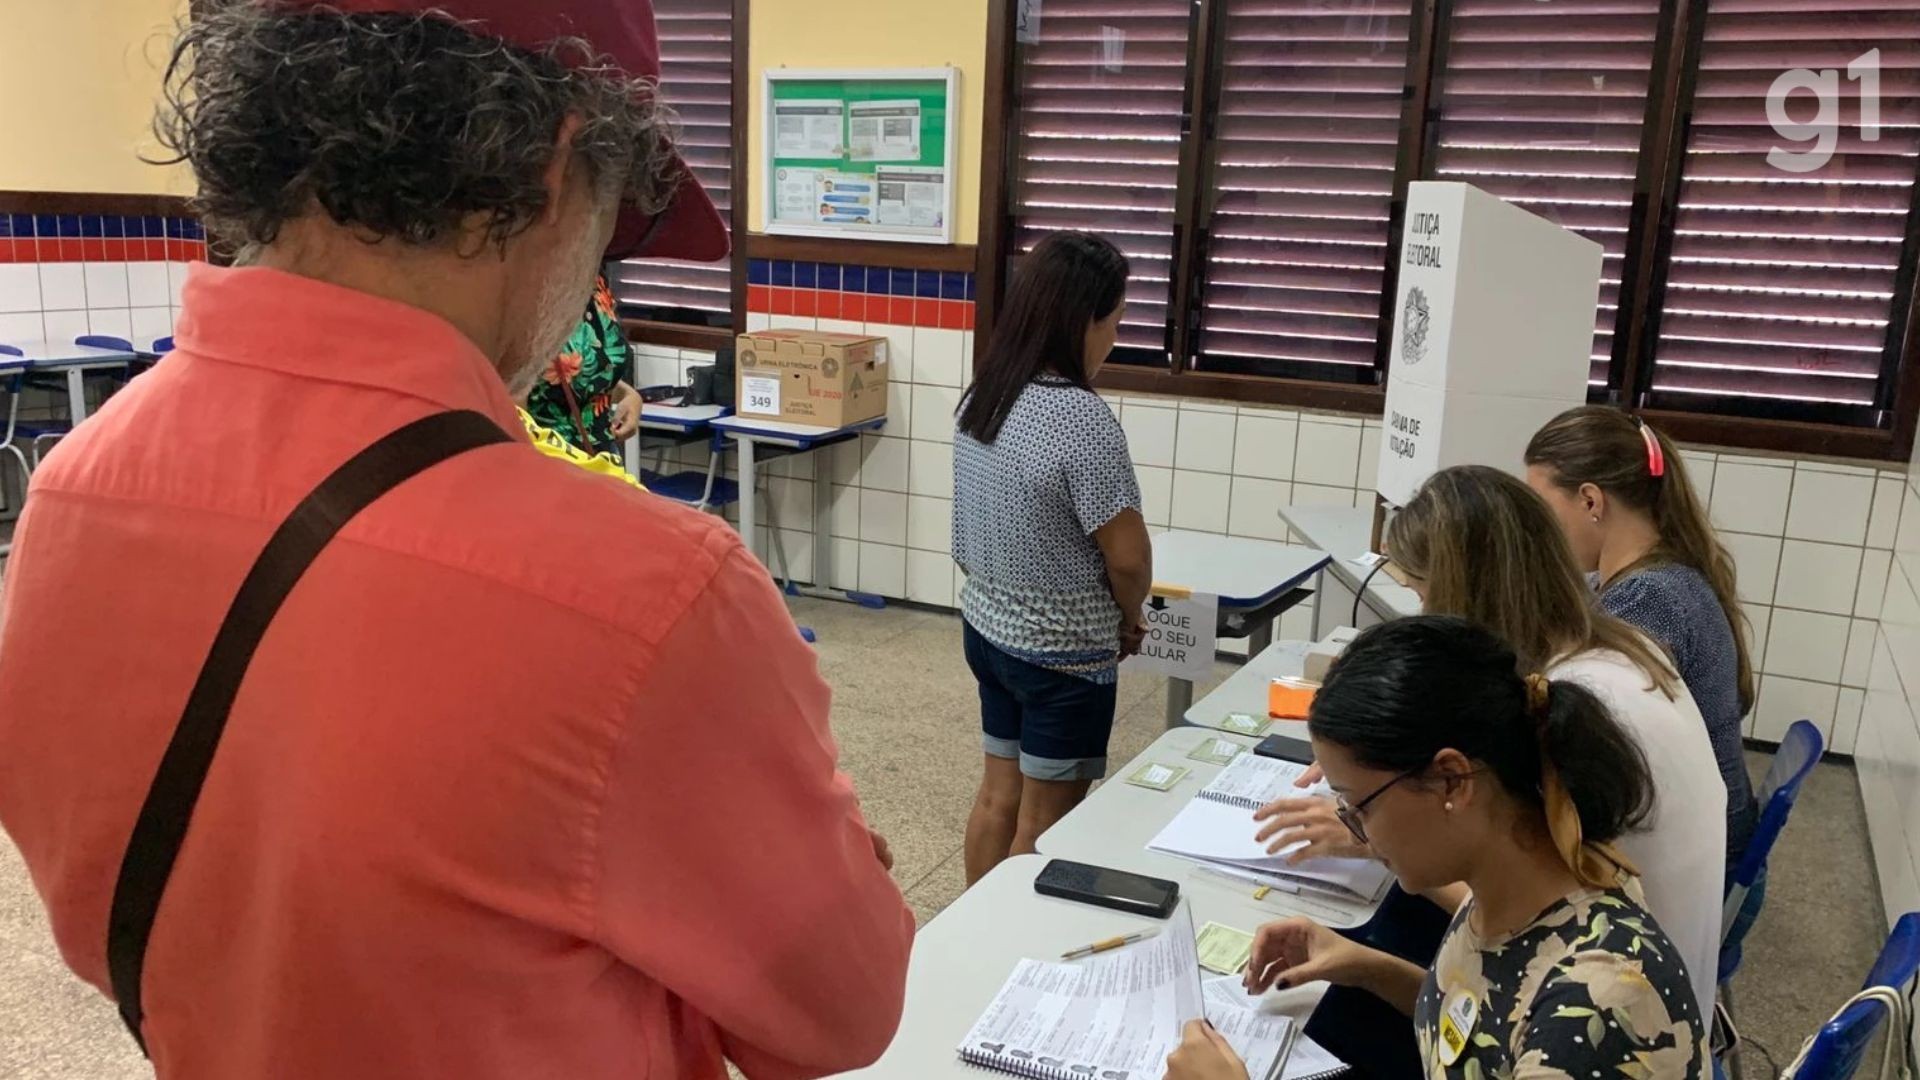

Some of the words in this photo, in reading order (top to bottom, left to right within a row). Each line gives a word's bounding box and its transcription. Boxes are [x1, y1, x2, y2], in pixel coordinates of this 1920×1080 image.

[750, 394, 772, 408] 349
[1409, 418, 1421, 436] DE
[1166, 630, 1197, 647] SEU
